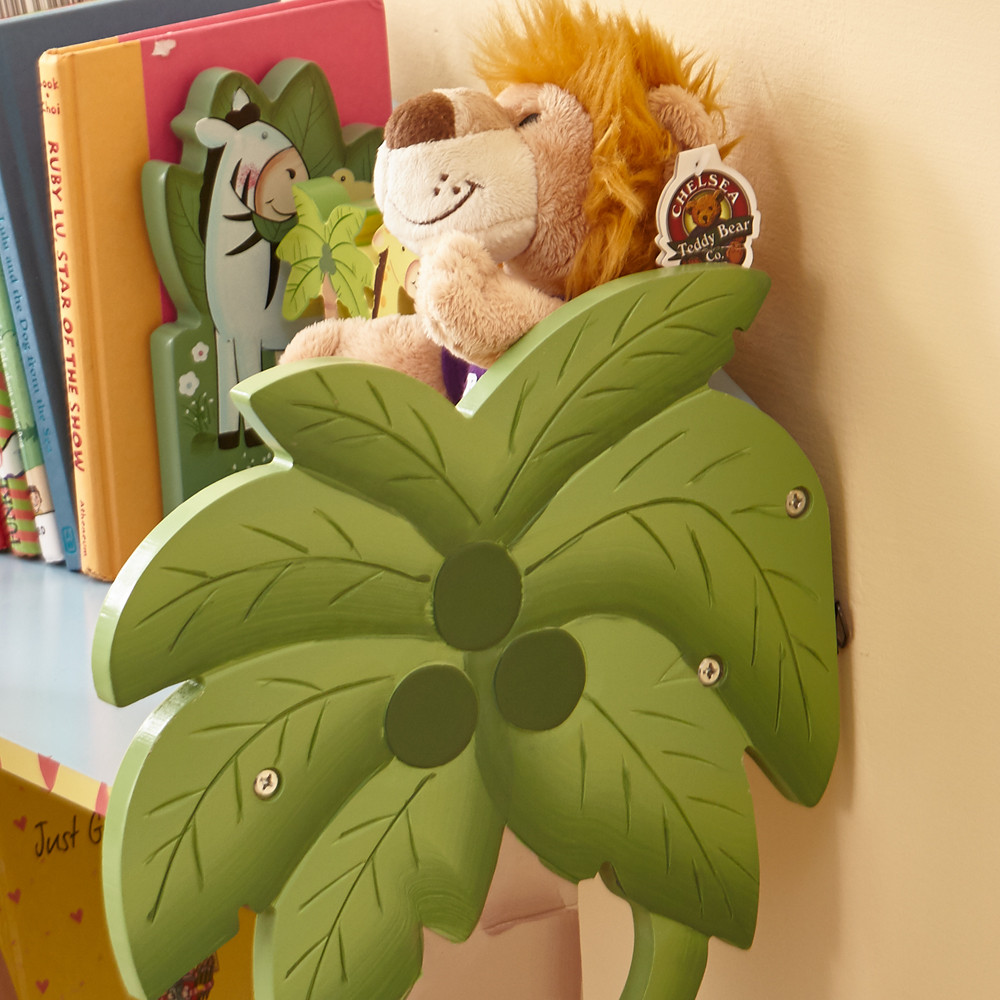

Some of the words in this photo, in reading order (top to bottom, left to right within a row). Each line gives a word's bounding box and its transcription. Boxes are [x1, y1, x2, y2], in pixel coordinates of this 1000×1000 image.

[40, 77, 59, 90] ook
[48, 140, 63, 202] RUBY
[671, 173, 740, 218] CHELSEA
[677, 232, 715, 257] Teddy
[717, 219, 750, 239] Bear
[705, 250, 725, 262] Co.
[57, 251, 72, 308] STAR
[5, 256, 18, 284] and
[13, 289, 24, 312] the
[19, 319, 31, 352] Dog
[27, 356, 40, 393] from
[36, 399, 46, 422] the
[43, 427, 53, 453] Sea
[63, 317, 75, 348] OF
[66, 353, 79, 395] THE
[70, 403, 85, 472] SHOW
[34, 813, 79, 857] Just
[88, 811, 103, 845] G
